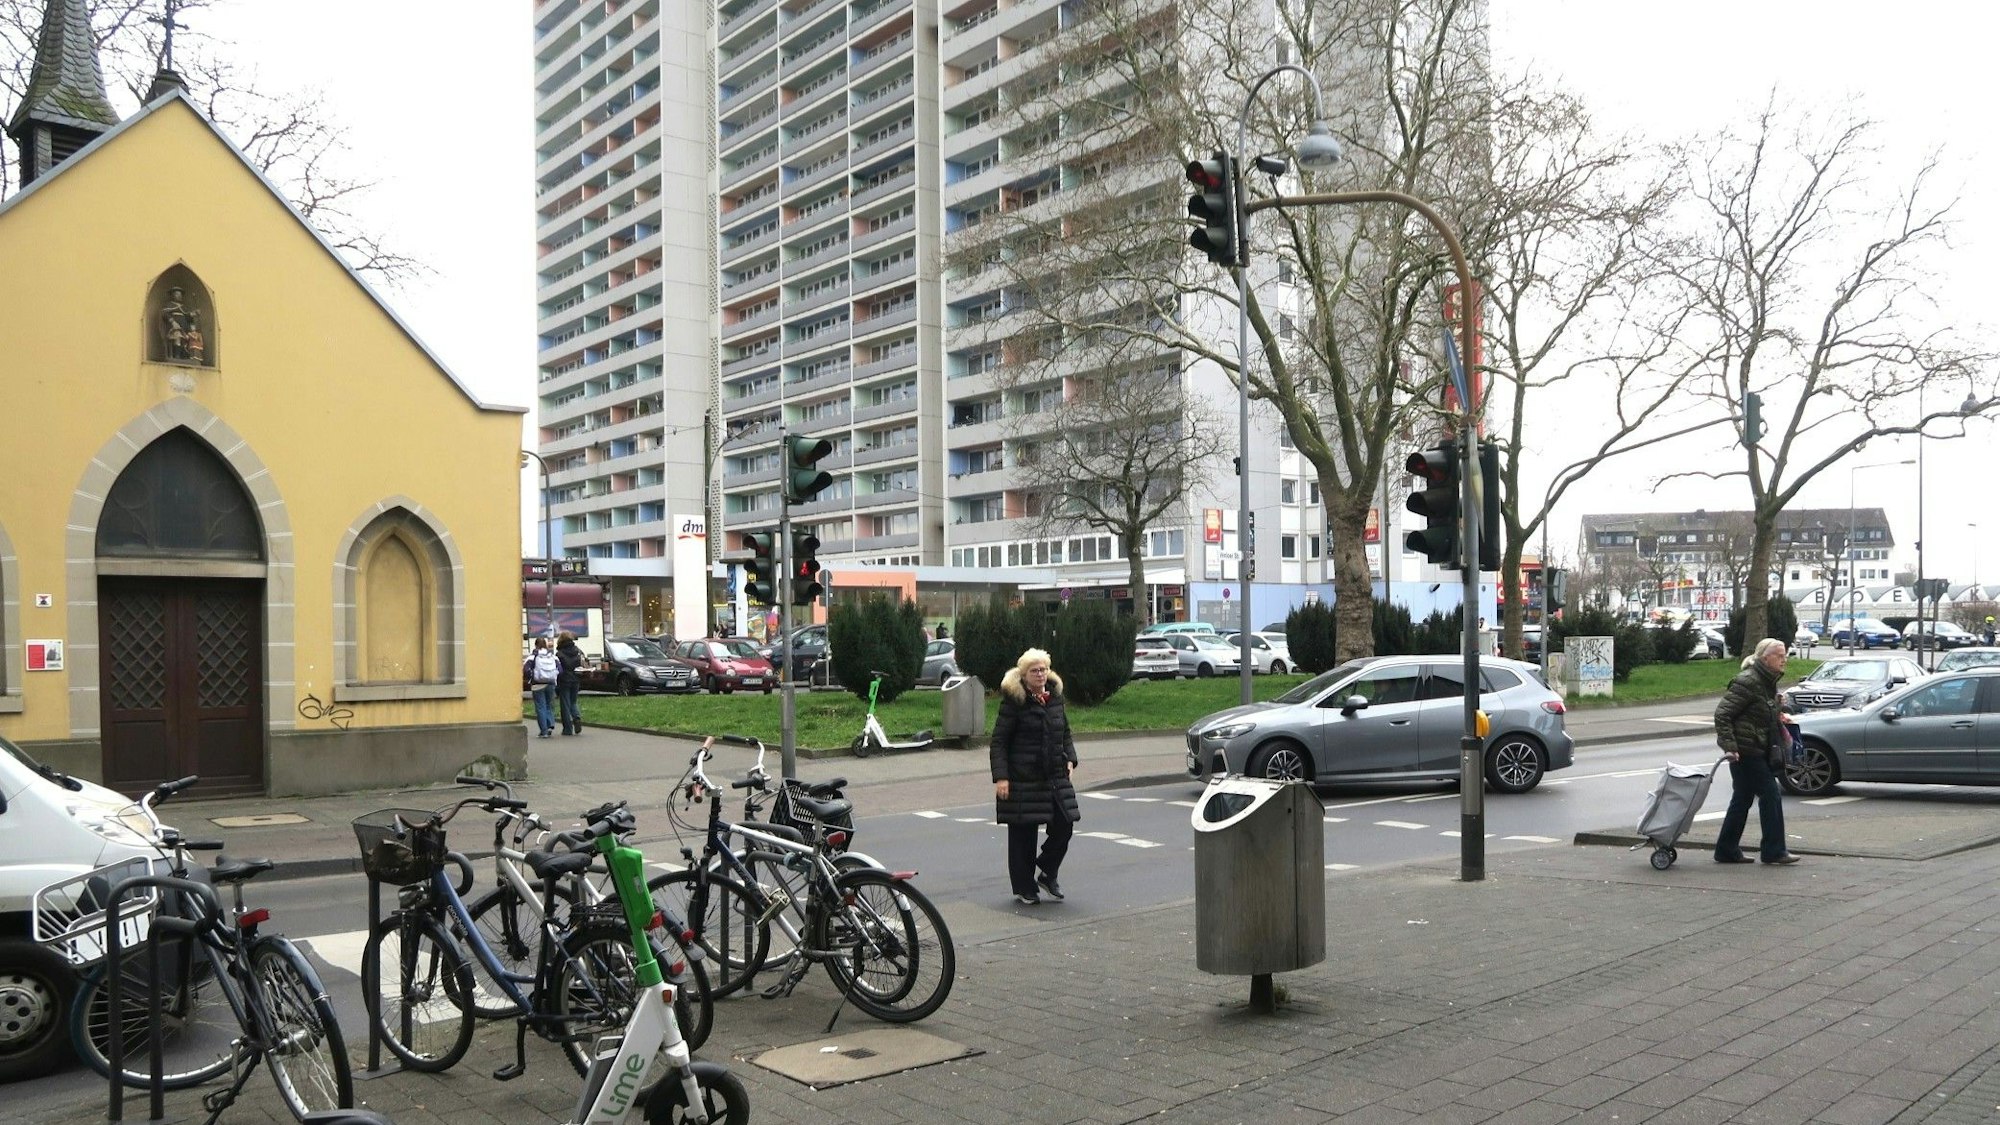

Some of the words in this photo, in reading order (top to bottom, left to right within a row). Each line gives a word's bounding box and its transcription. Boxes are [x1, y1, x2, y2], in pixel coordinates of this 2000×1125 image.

[682, 519, 704, 533] dm
[532, 566, 548, 574] NEV
[601, 1053, 646, 1116] Lime
